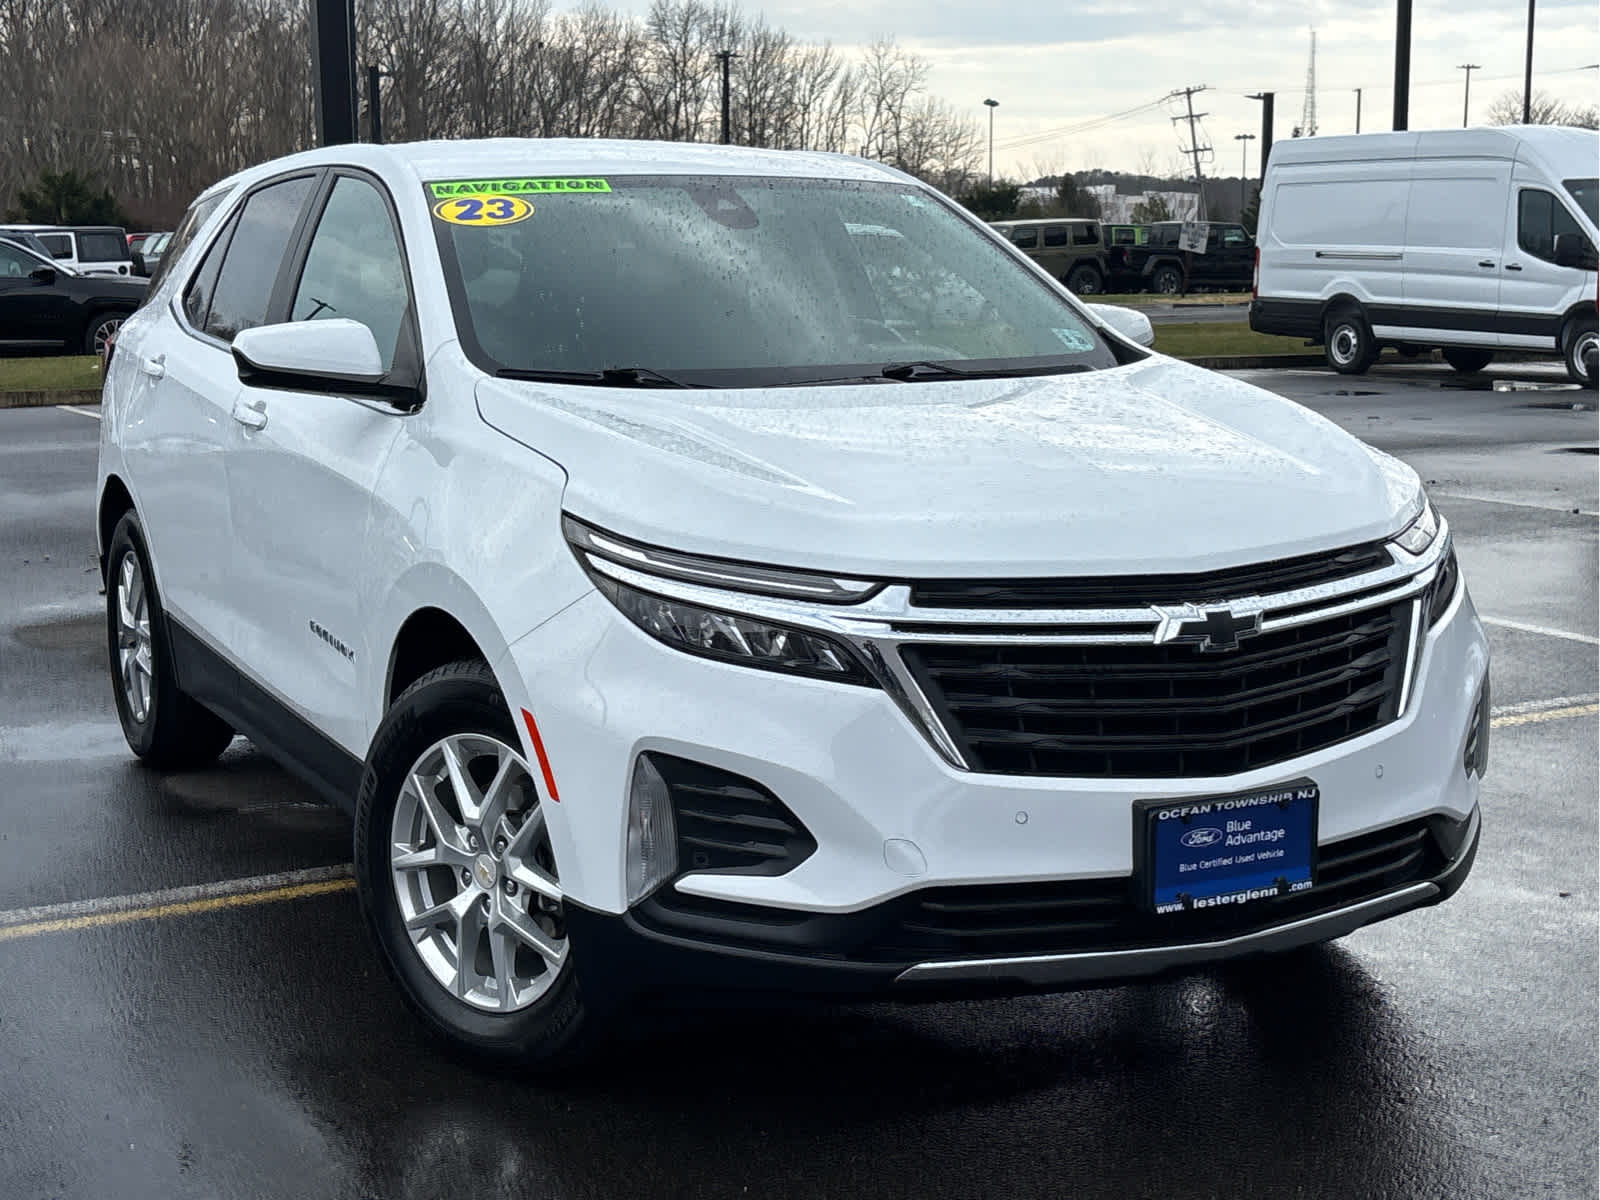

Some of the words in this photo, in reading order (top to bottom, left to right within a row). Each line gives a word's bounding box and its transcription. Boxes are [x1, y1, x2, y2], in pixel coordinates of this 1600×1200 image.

[435, 180, 605, 195] NAVIGATION
[455, 198, 515, 220] 23
[1159, 805, 1211, 820] OCEAN
[1215, 792, 1293, 811] TOWNSHIP
[1297, 789, 1316, 799] NJ
[1225, 828, 1286, 847] Advantage
[1226, 820, 1252, 833] Blue
[1179, 863, 1197, 872] Blue
[1199, 857, 1233, 868] Certified
[1234, 853, 1256, 864] Used
[1257, 849, 1284, 860] Vehicle
[1156, 903, 1184, 914] www.
[1193, 887, 1278, 909] lesterglenn
[1288, 880, 1313, 893] .com
